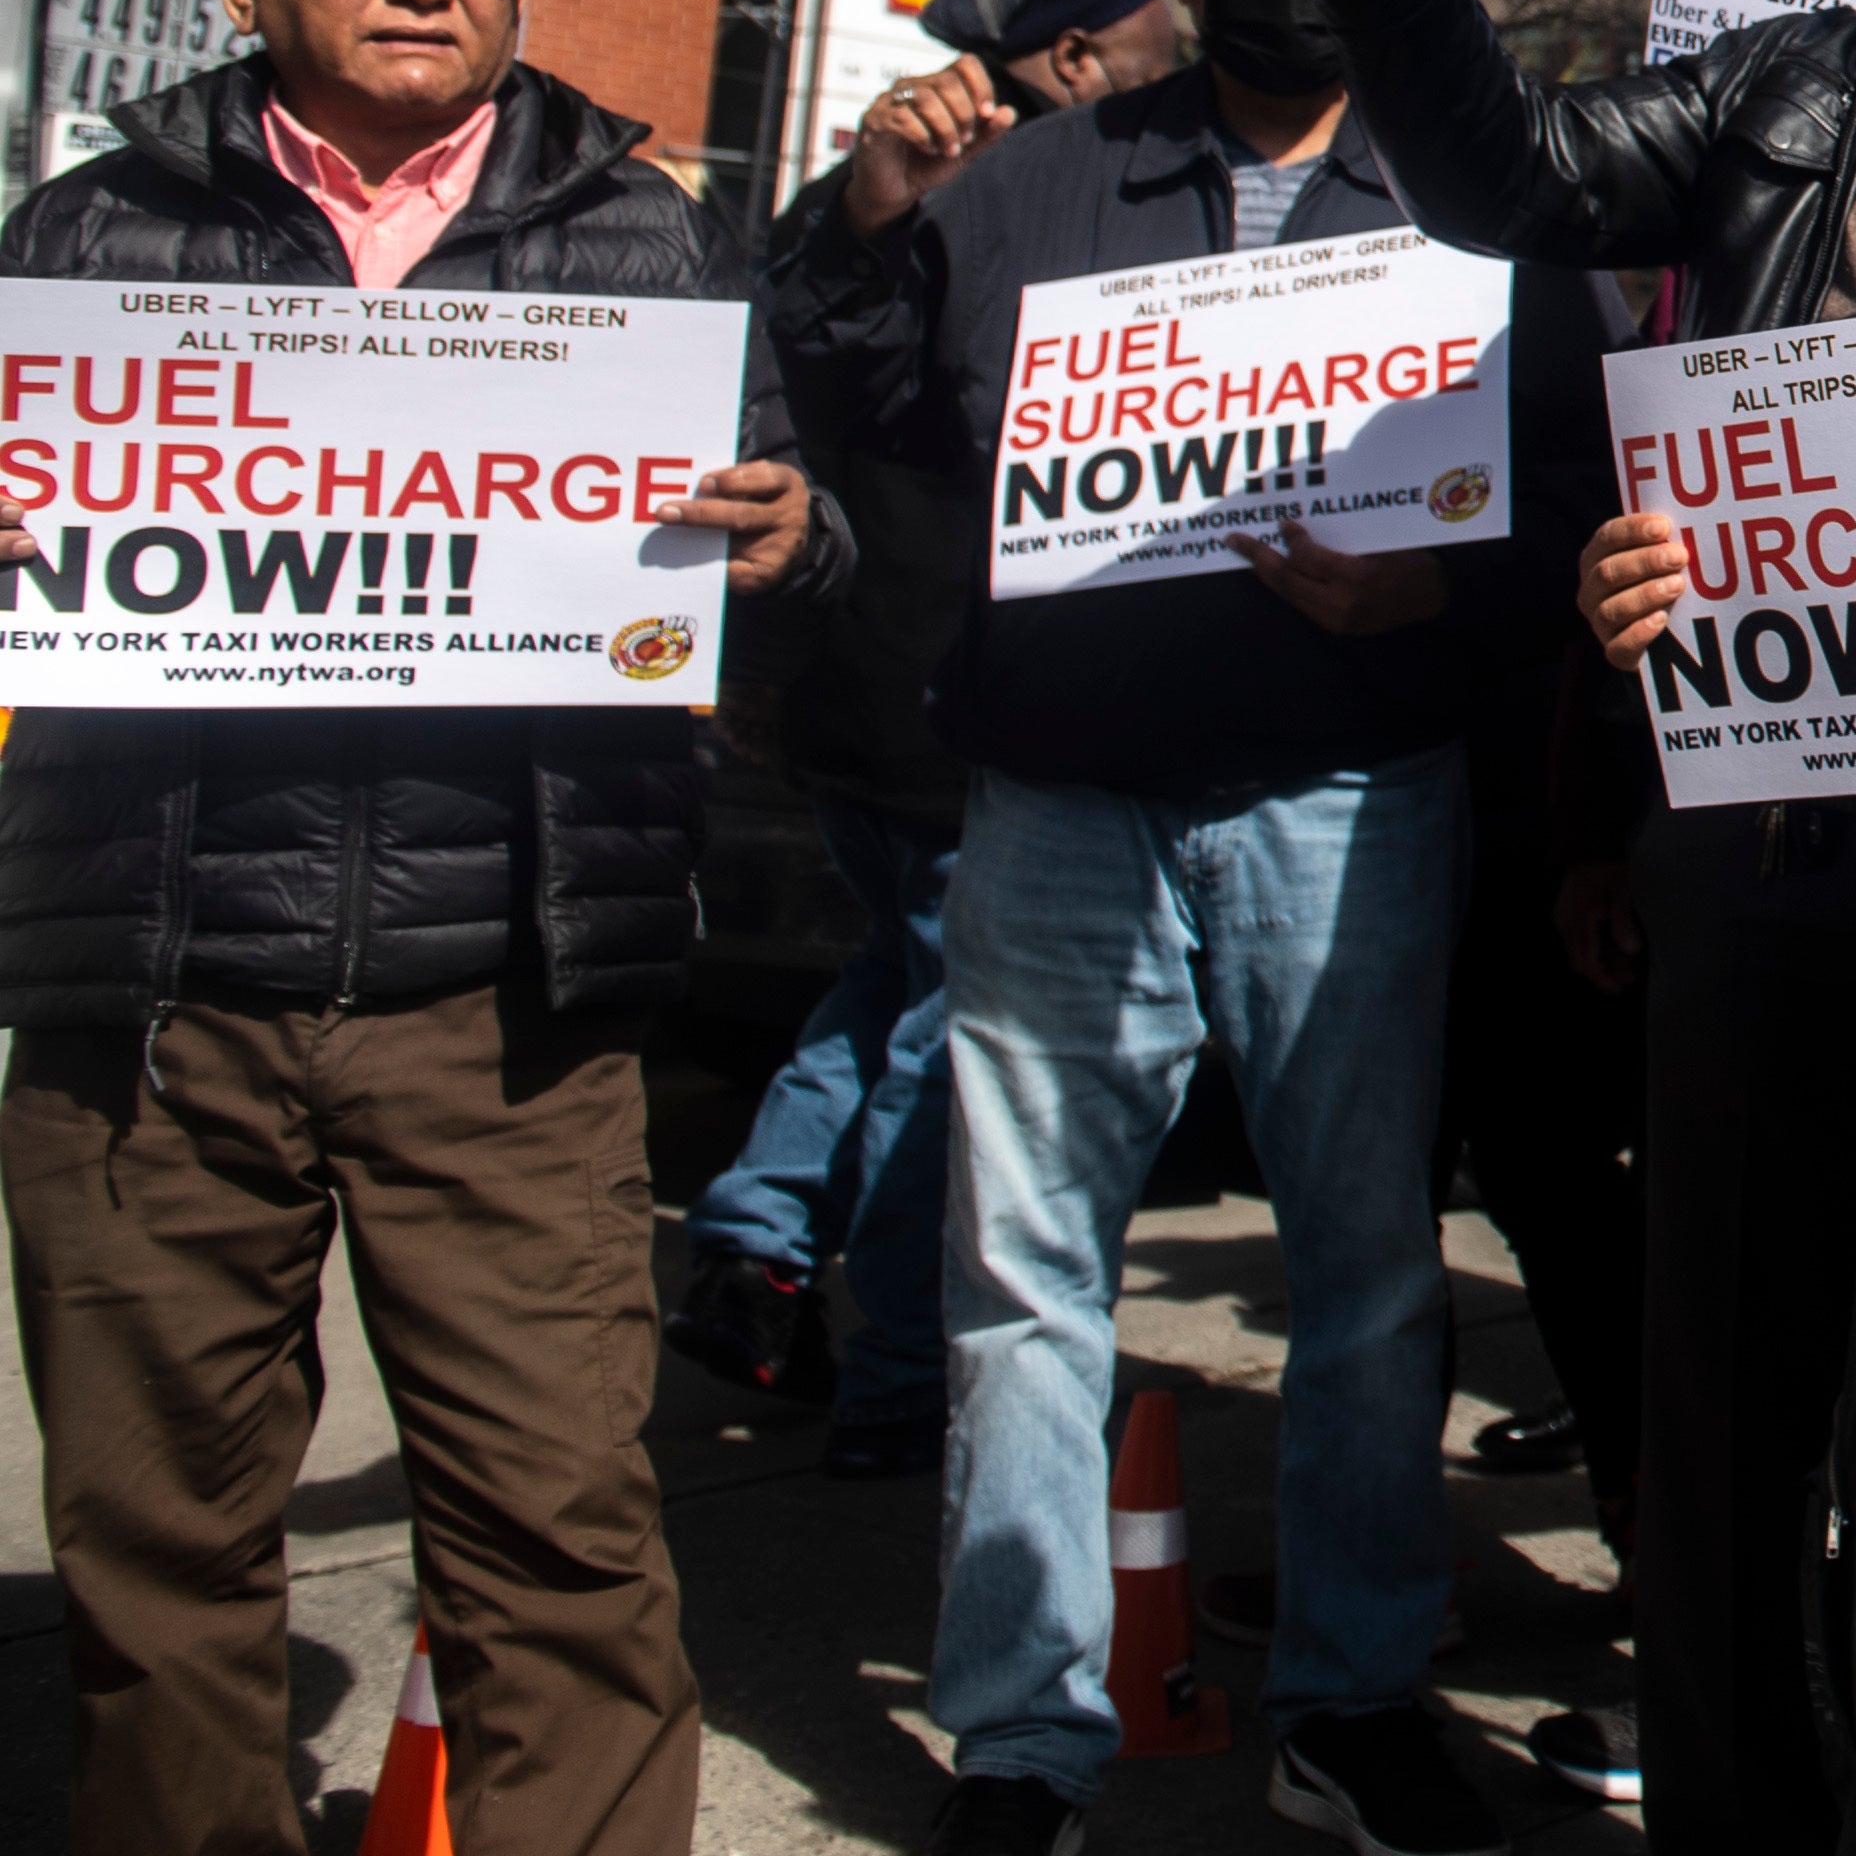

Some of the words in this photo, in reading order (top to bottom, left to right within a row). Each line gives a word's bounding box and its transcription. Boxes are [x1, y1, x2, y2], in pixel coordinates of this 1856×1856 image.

[1650, 24, 1708, 49] EVERY
[121, 293, 209, 314] UBER
[248, 297, 324, 317] LYFT
[360, 300, 489, 322] YELLOW
[524, 305, 626, 327] GREEN
[1020, 318, 1202, 390] FUEL
[1683, 348, 1749, 377] UBER
[1774, 335, 1835, 364] LYFT
[2, 354, 290, 429] FUEL
[1007, 336, 1482, 452] SURCHARGE
[1733, 387, 1779, 413] ALL
[0, 438, 694, 524] SURCHARGE
[1003, 420, 1330, 528] NOW!!!
[1621, 417, 1837, 517] FUEL
[74, 633, 168, 651] YORK
[181, 632, 258, 651] TAXI
[271, 632, 434, 652] WORKERS
[446, 633, 603, 652] ALLIANCE
[164, 663, 416, 686] www.nytwa.org
[1664, 726, 1721, 751] NEW
[1728, 719, 1802, 745] YORK
